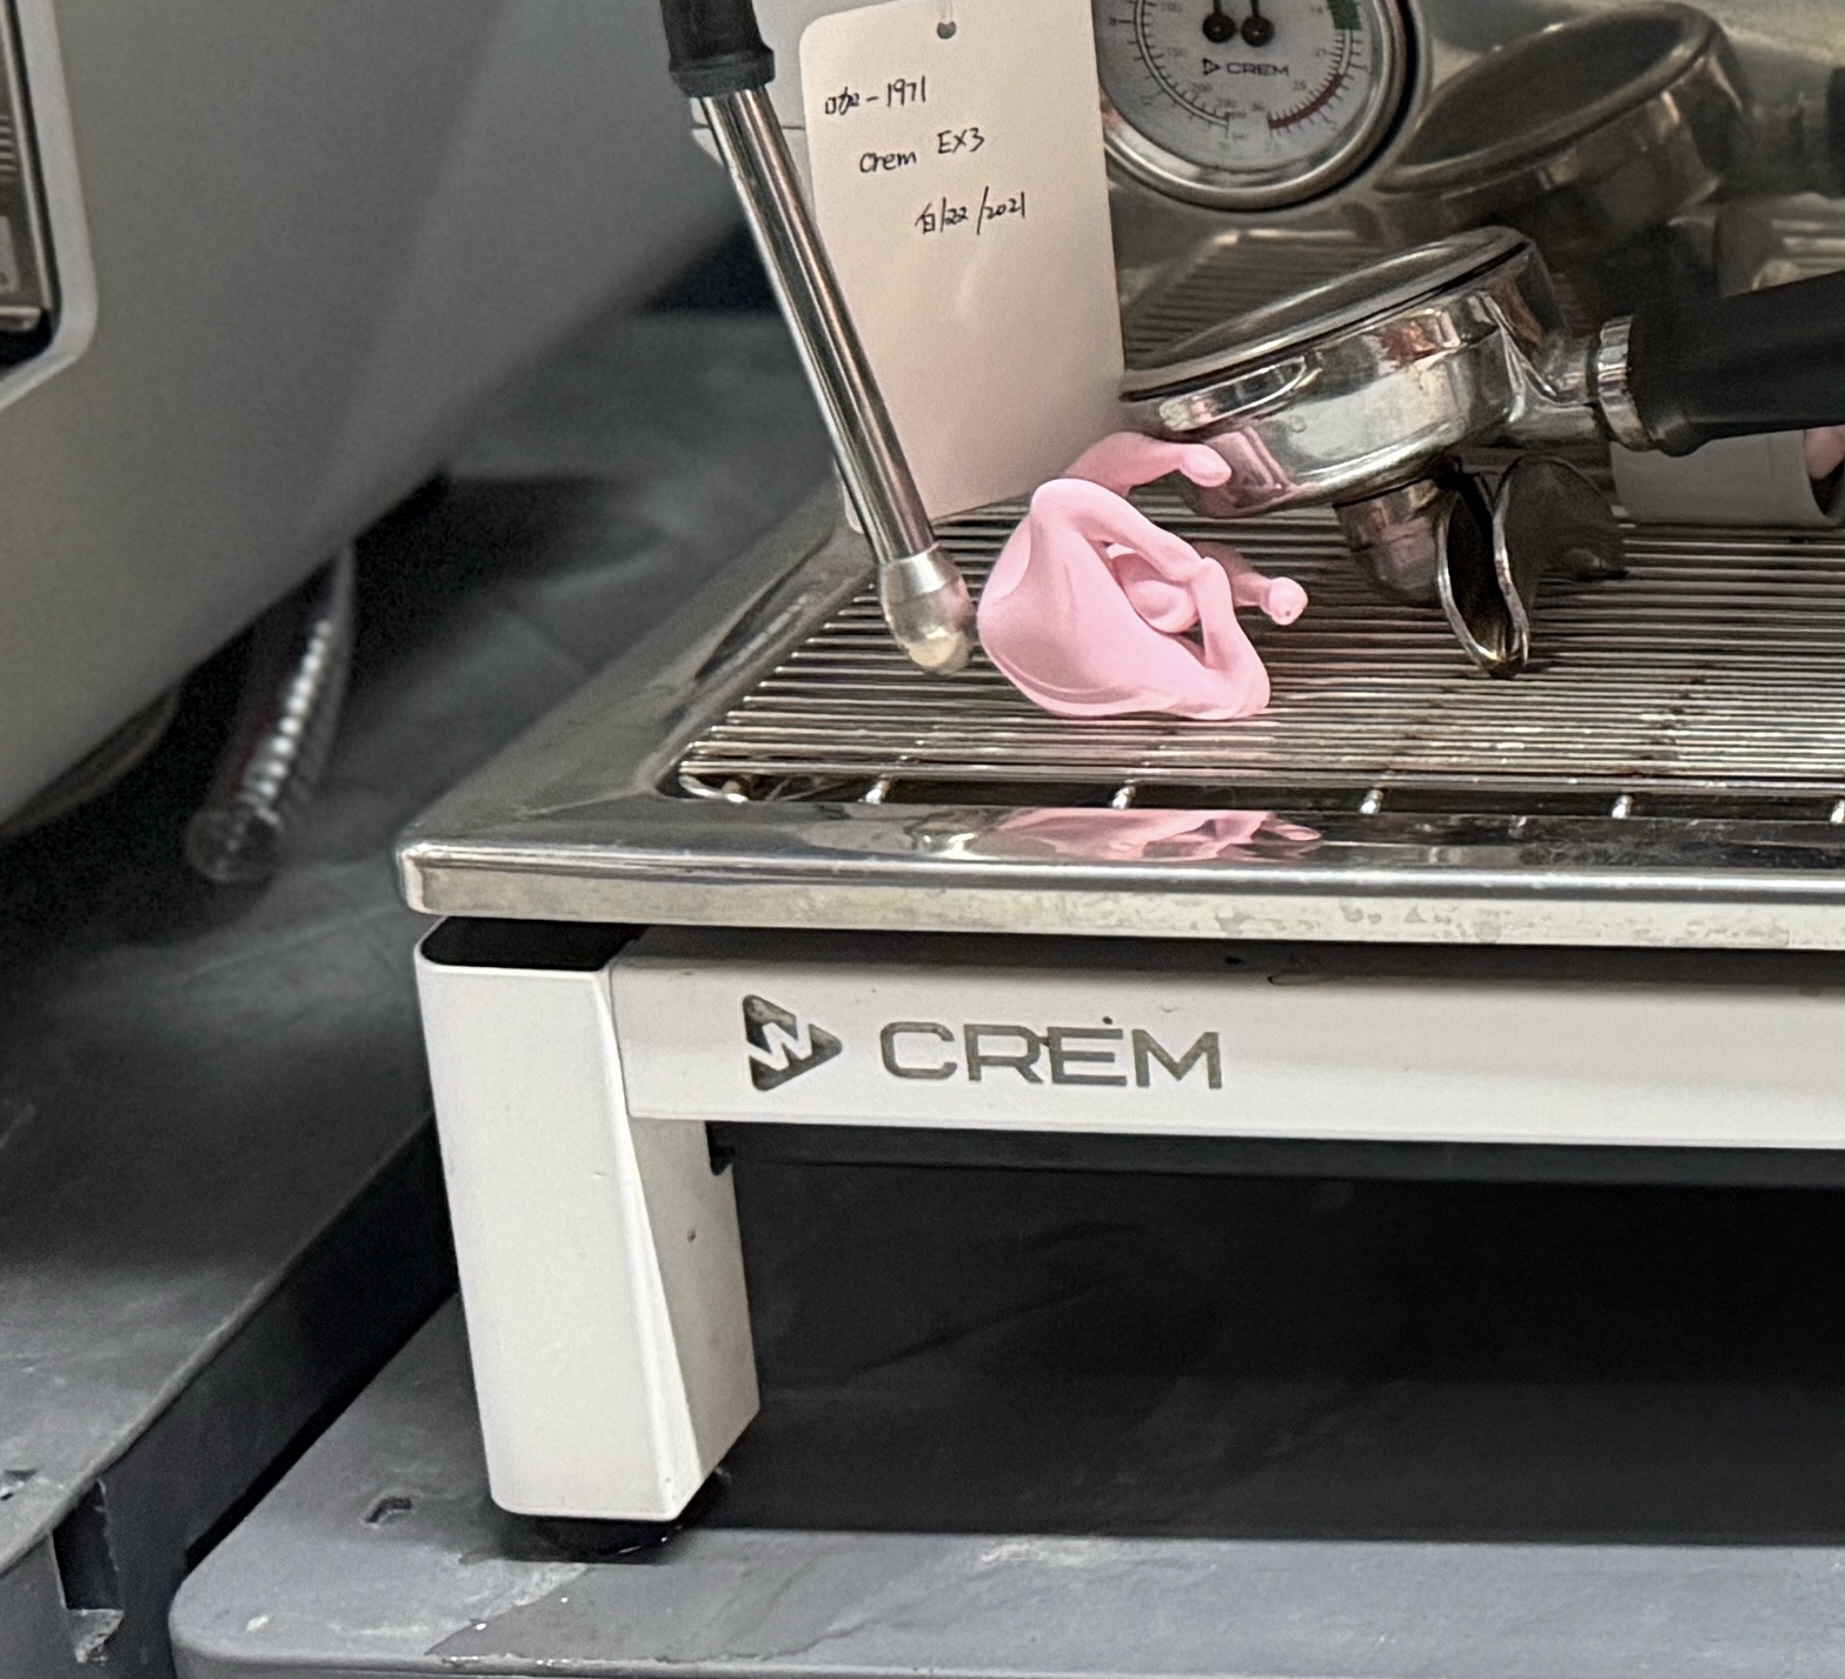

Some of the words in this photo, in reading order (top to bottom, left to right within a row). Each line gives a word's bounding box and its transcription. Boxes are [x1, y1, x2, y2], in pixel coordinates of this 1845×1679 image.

[1226, 61, 1290, 77] CREM
[936, 126, 986, 155] EX3
[880, 1020, 1223, 1090] CREM
